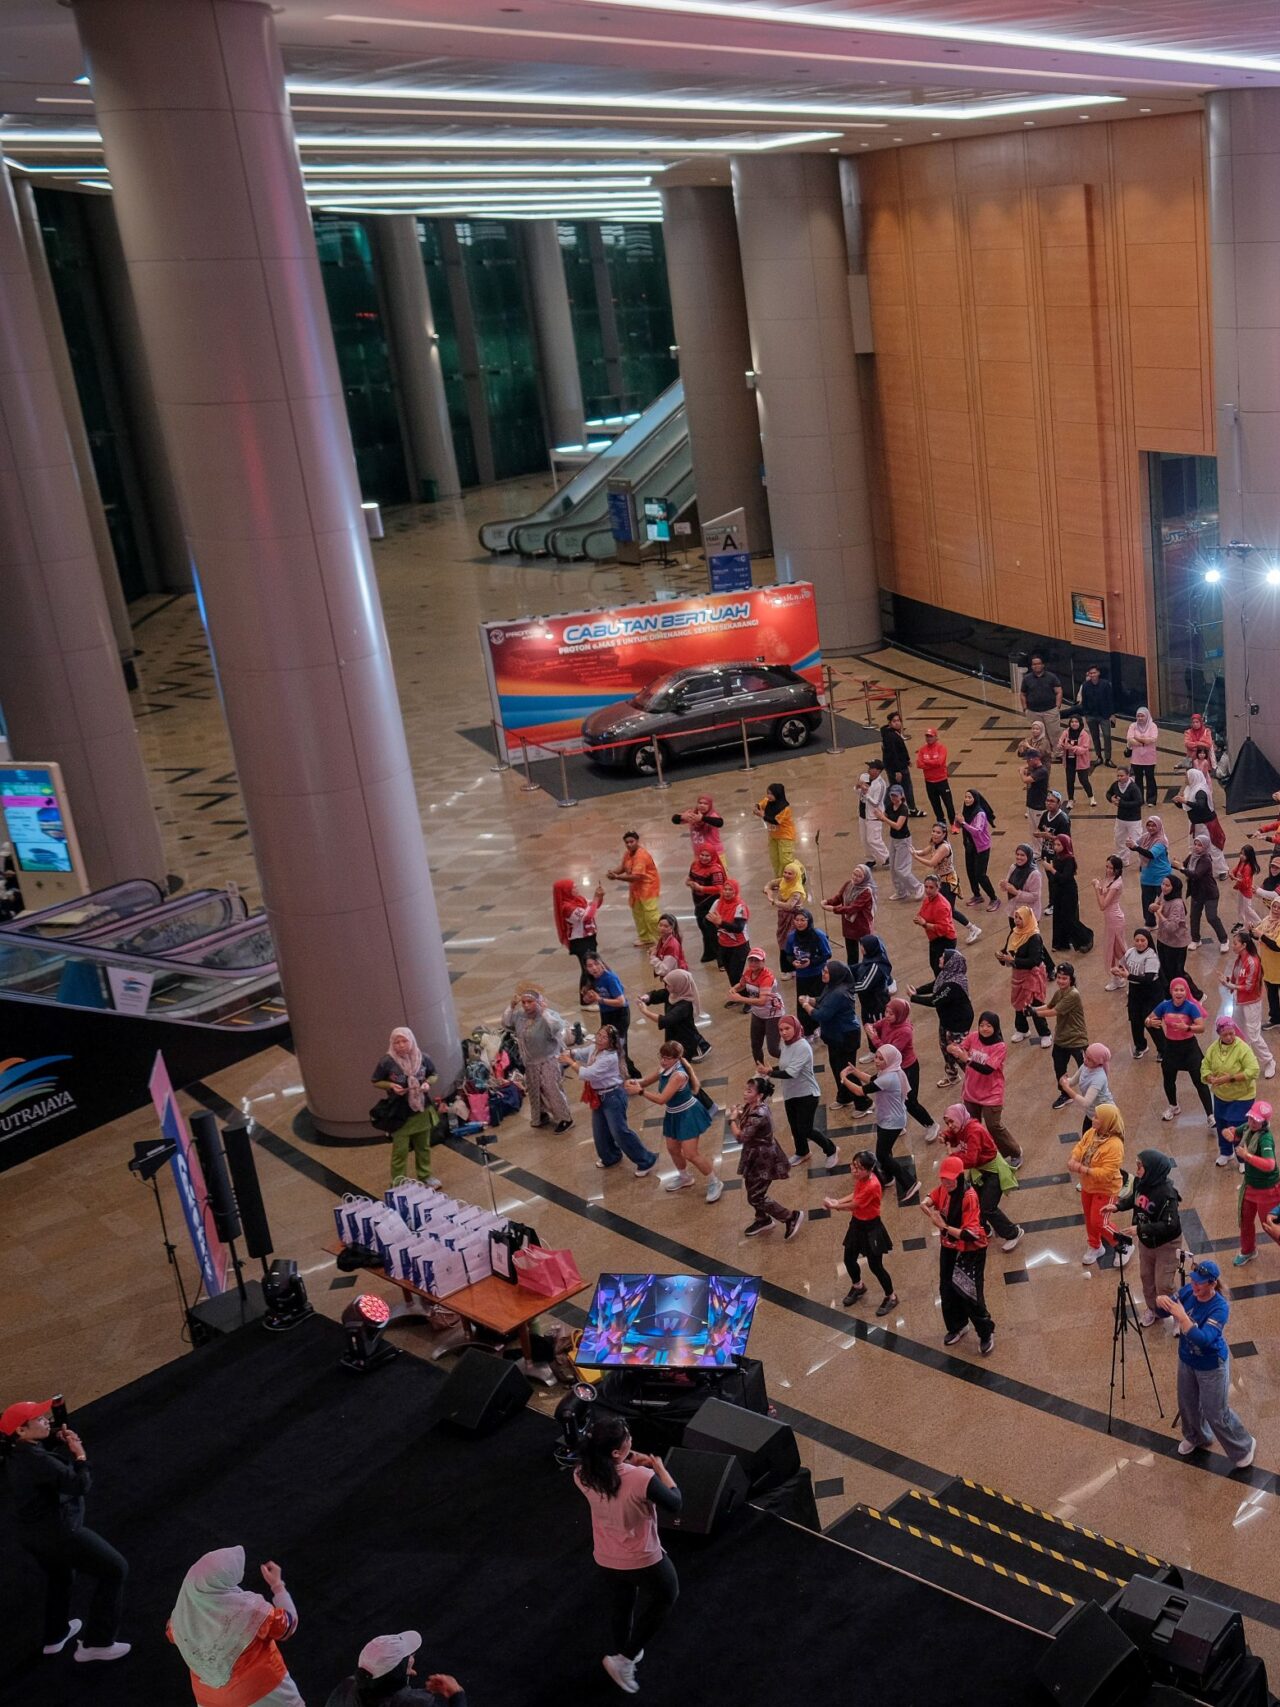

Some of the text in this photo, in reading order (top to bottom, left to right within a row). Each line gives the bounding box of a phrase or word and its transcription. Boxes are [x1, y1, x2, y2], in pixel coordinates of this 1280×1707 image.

[722, 534, 738, 551] A
[565, 603, 750, 643] CABUTAN BERTUAH
[558, 644, 592, 656] PROTON
[0, 1090, 75, 1132] UTRAJAYA
